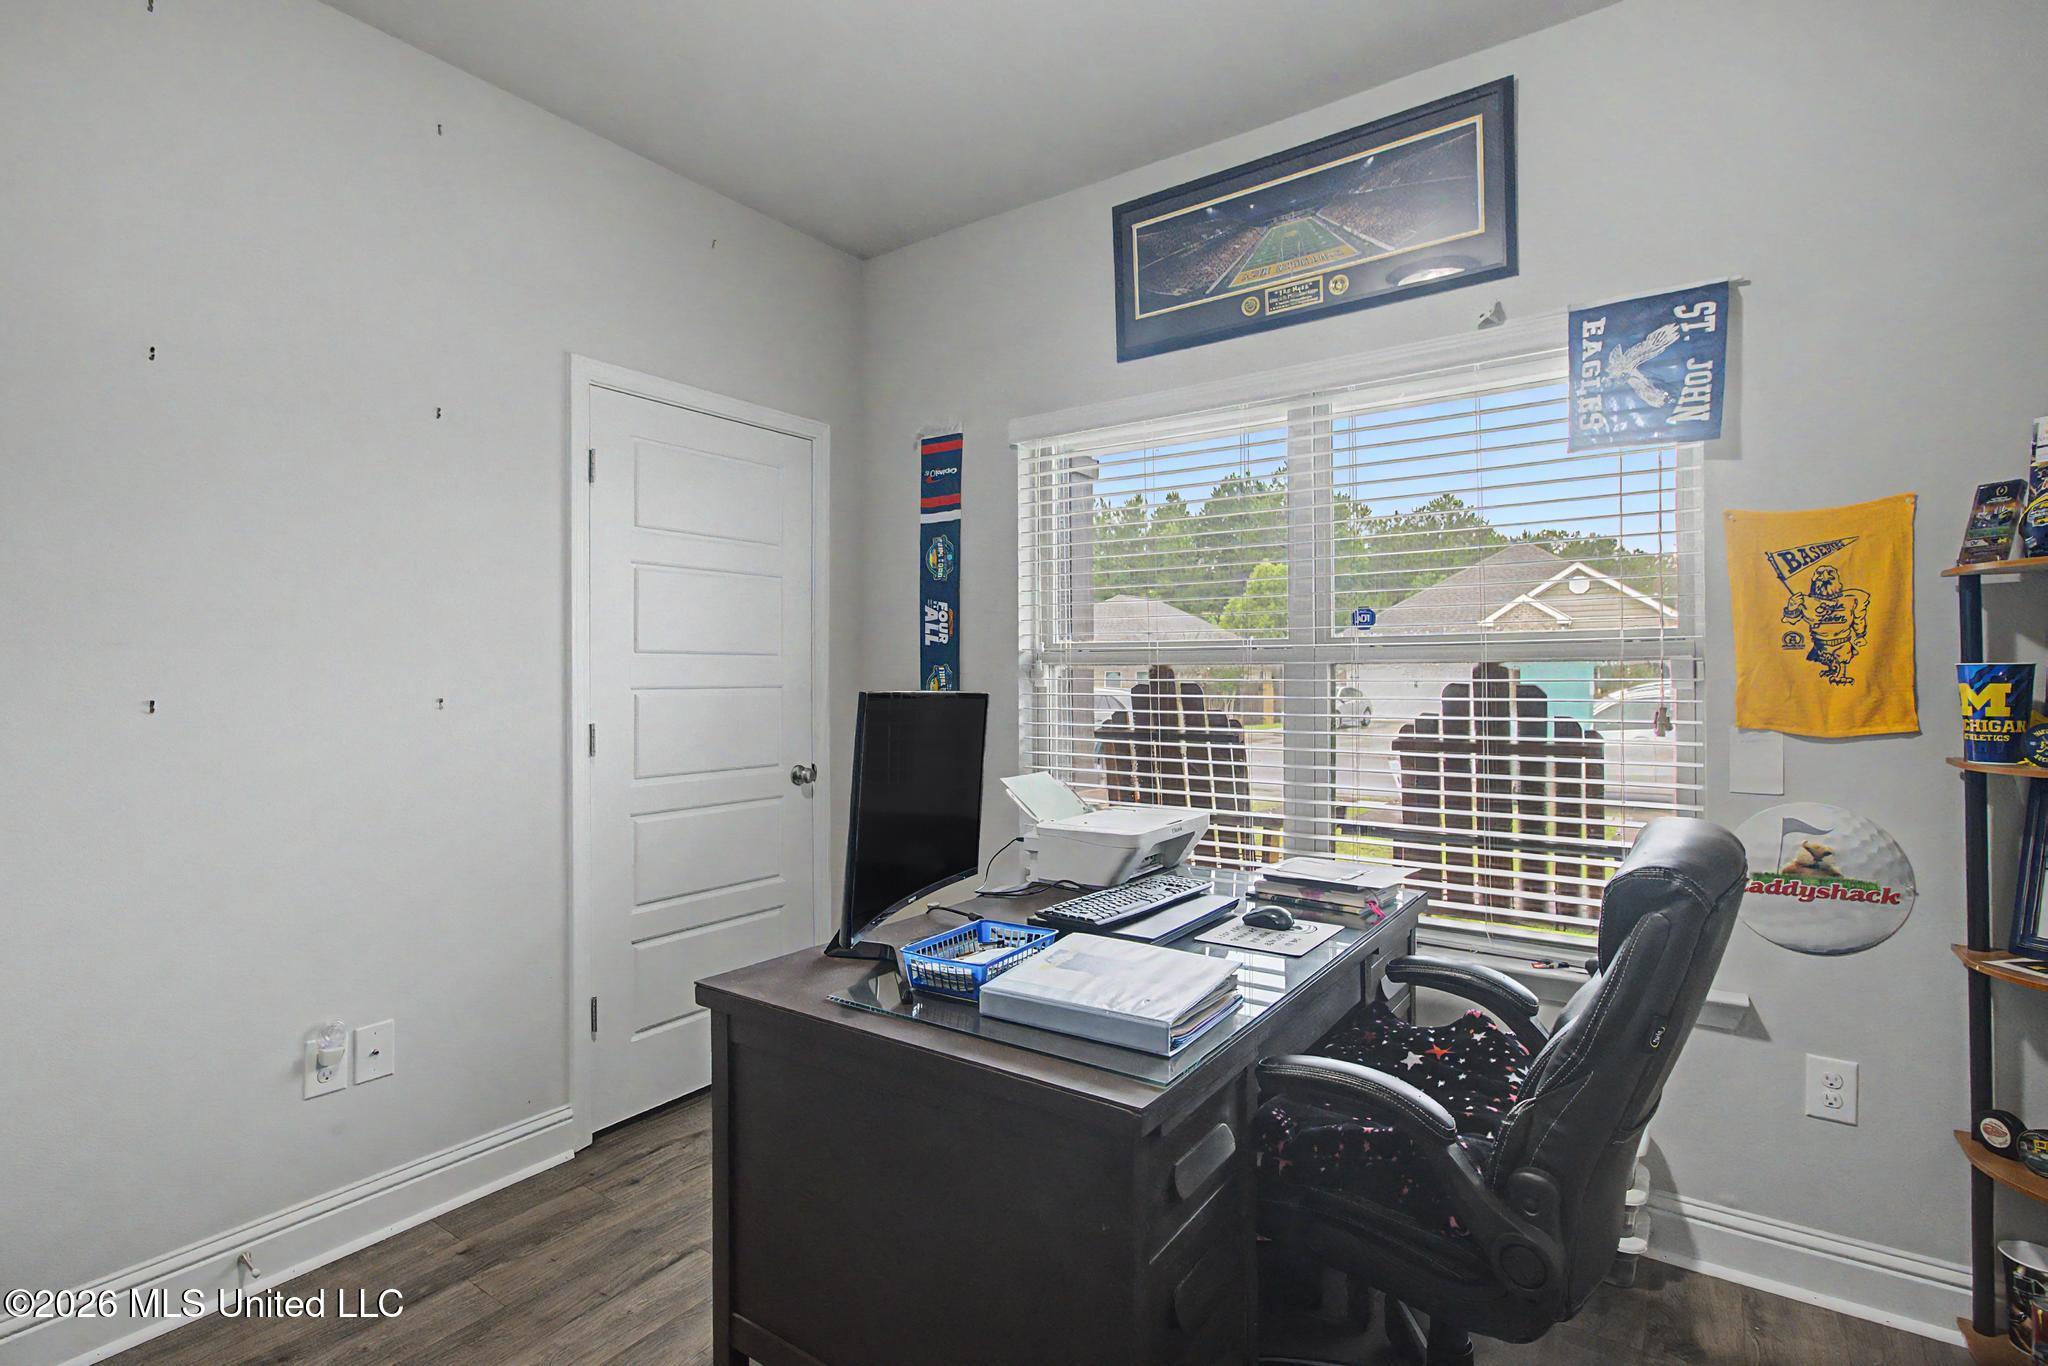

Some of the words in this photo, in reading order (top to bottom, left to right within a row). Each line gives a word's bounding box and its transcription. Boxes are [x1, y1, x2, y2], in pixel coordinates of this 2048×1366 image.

[1673, 301, 1717, 342] ST.
[1576, 316, 1609, 432] EAGLES
[1665, 358, 1714, 425] JOHN
[924, 605, 941, 646] ALL
[937, 601, 949, 644] FOUR
[1958, 683, 2012, 717] M
[1962, 719, 2027, 733] CHIGAN
[1744, 879, 1901, 905] addyshack
